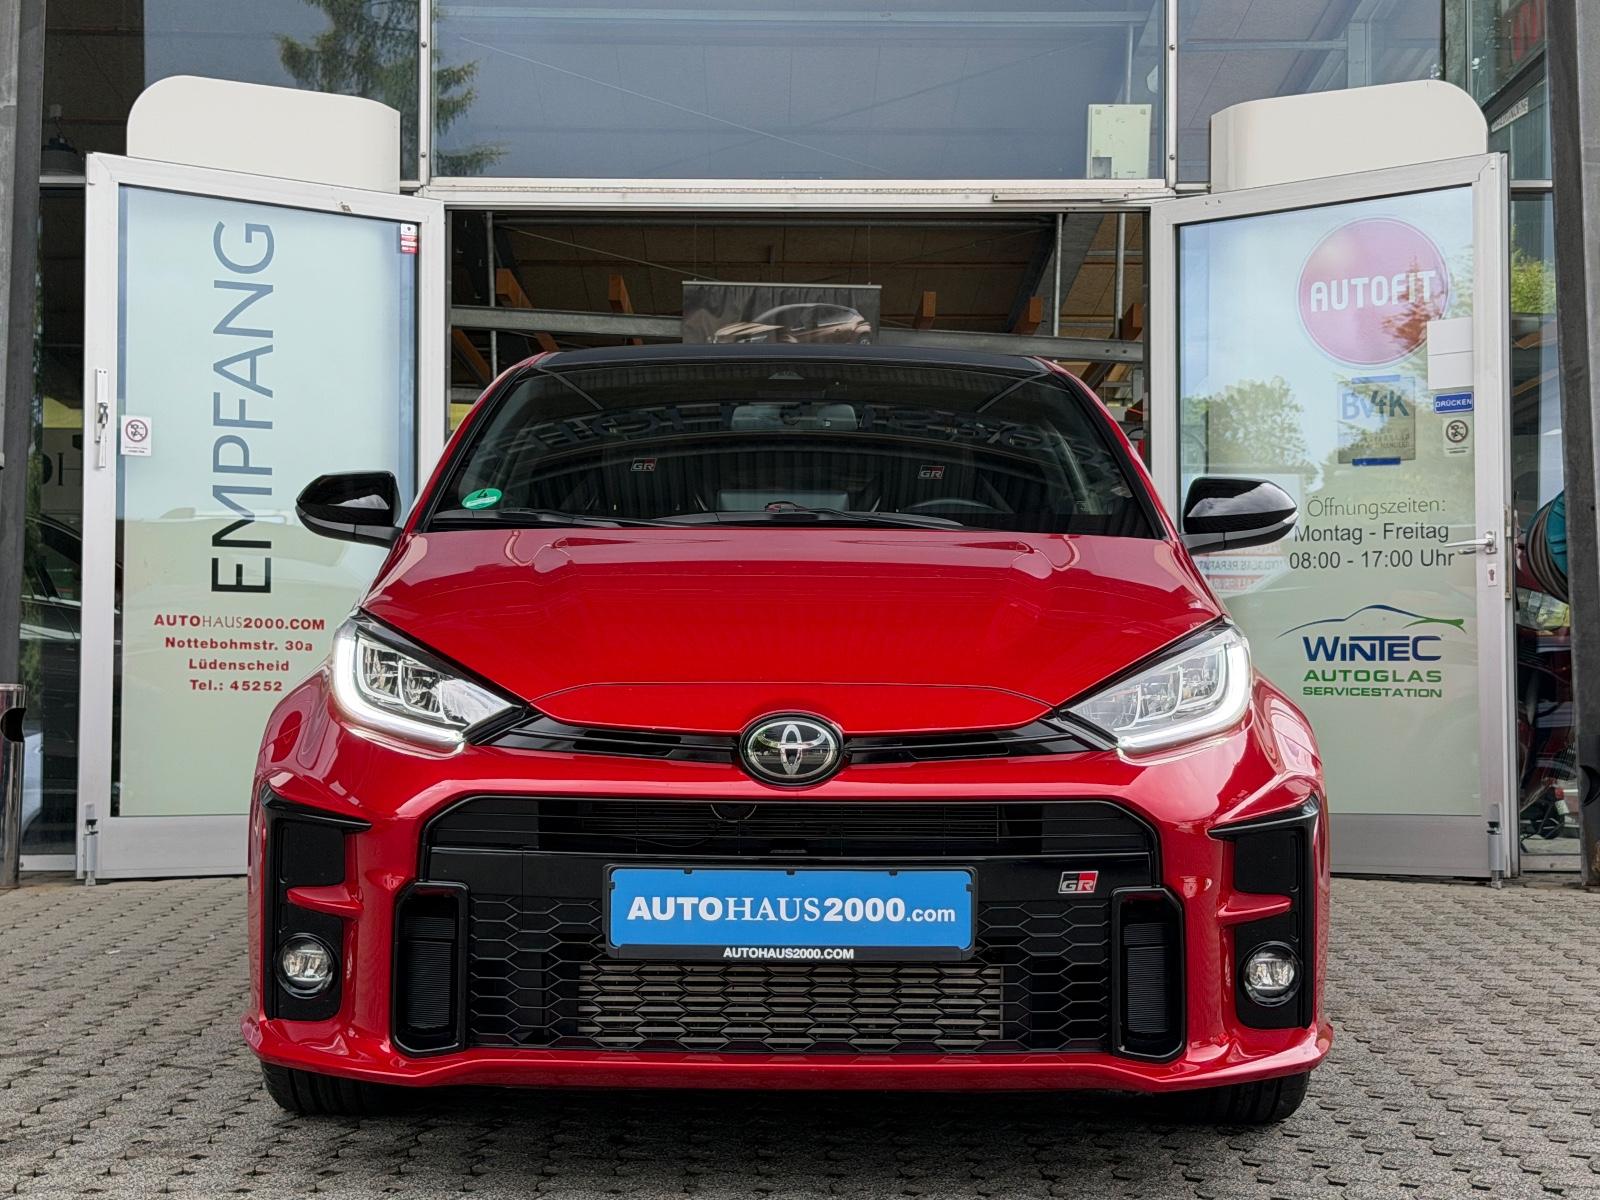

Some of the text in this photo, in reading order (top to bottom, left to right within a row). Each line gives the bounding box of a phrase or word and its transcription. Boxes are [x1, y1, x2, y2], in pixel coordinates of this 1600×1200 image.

[1311, 271, 1436, 312] AUTOFIT
[211, 221, 275, 593] EMPFANG
[1435, 398, 1472, 408] DRÜCKEN
[1307, 496, 1446, 520] Öffnungszeiten:
[1294, 525, 1363, 545] Montag
[1383, 522, 1449, 543] Freitag
[1289, 551, 1341, 569] 08:00
[1361, 550, 1413, 568] 17:00
[1420, 549, 1455, 567] Uhr
[154, 614, 325, 630] AUTOHAUS2000.COM
[165, 637, 313, 651] Nottebohmstr. 30a
[189, 658, 289, 671] Lüdenscheid
[1304, 670, 1442, 683] AUTOGLAS
[190, 679, 282, 691] Tel.: 45252
[1303, 687, 1442, 698] SERVICESTATION
[627, 896, 956, 922] AUTOHAUS2000.com
[723, 947, 854, 960] AUTOHAUS2000.COM
